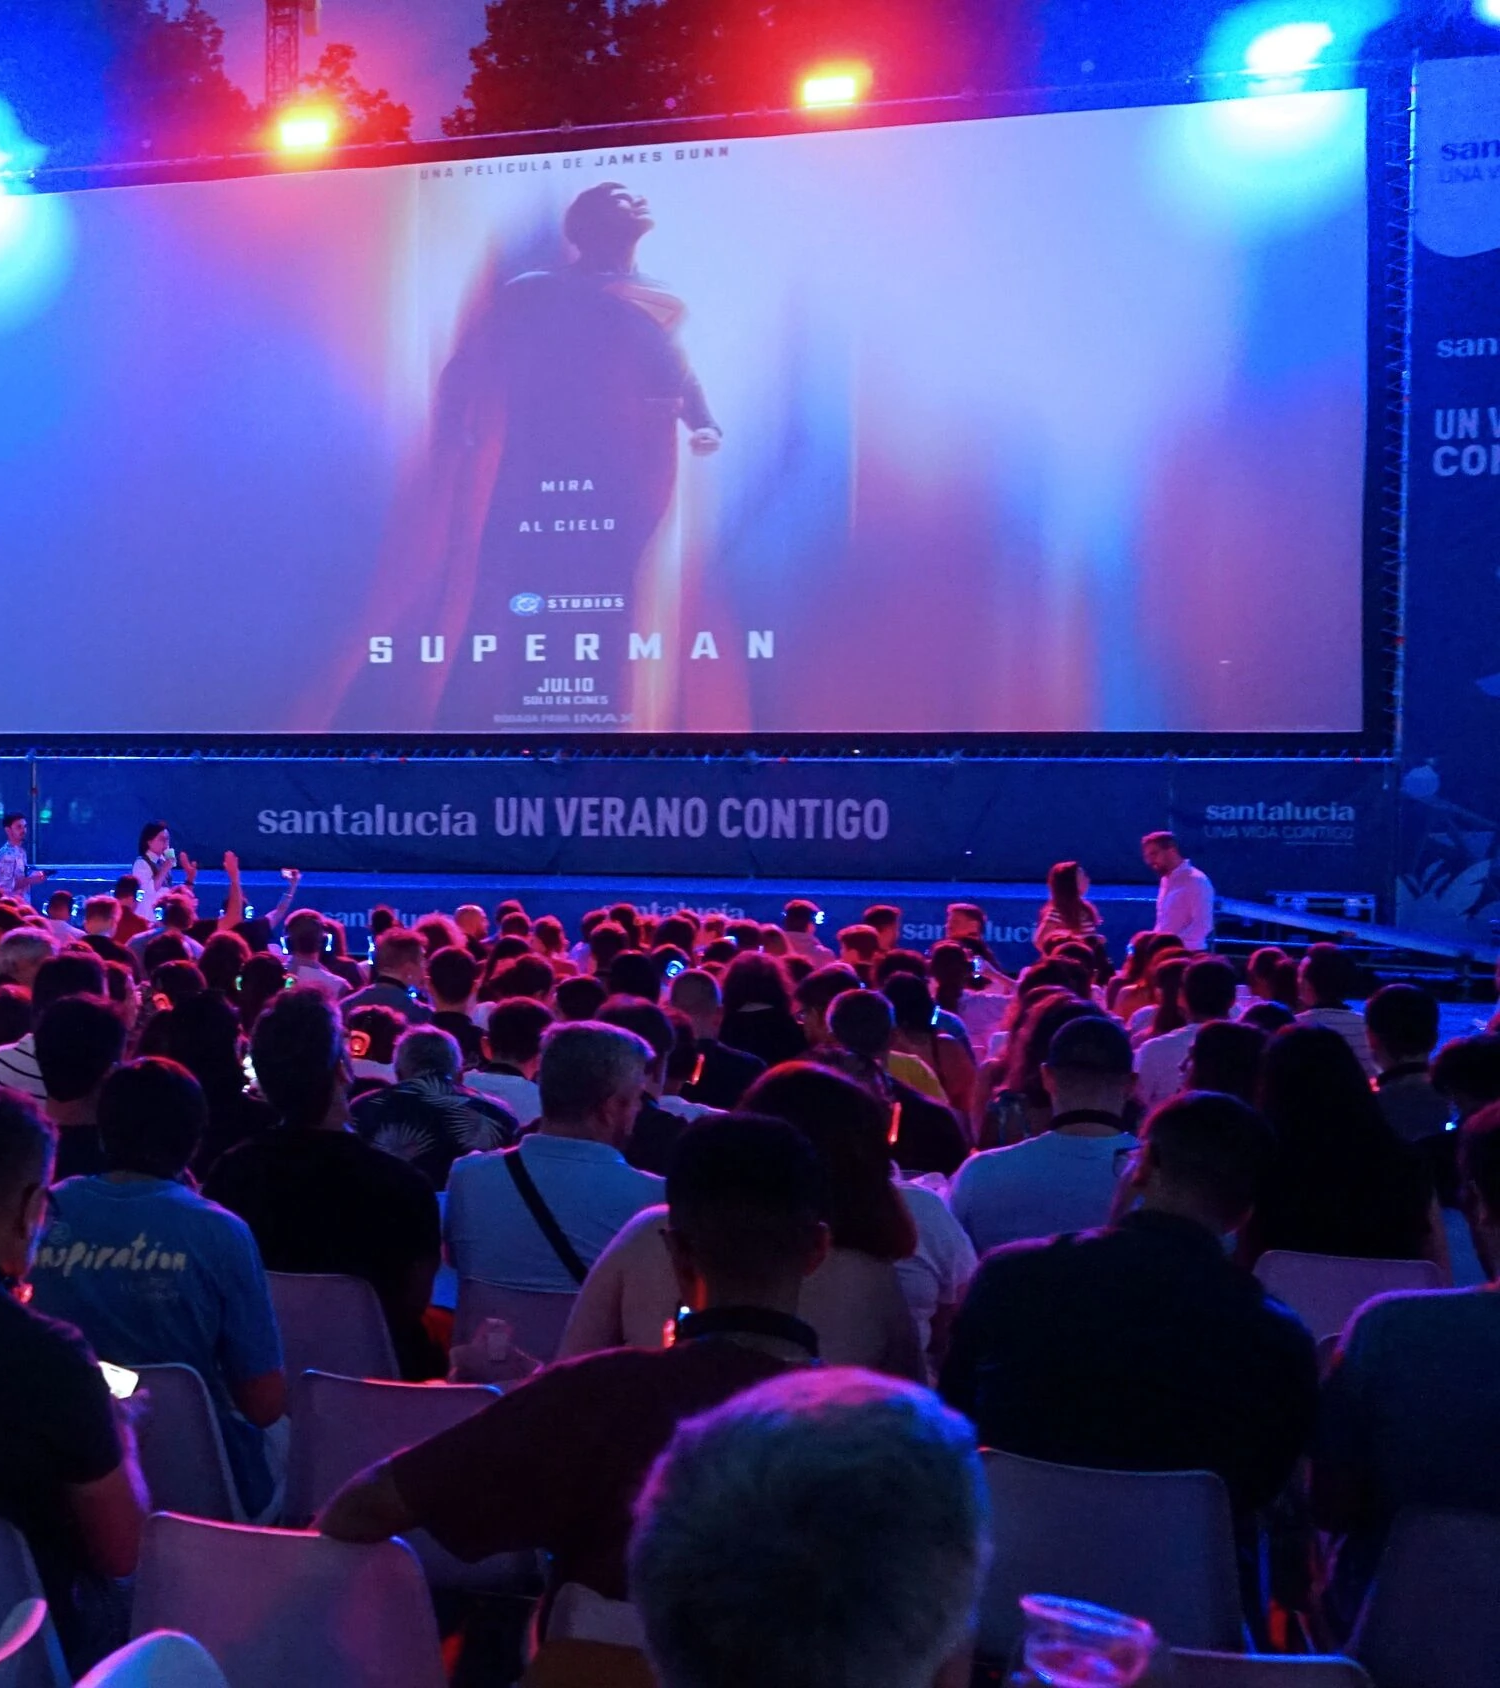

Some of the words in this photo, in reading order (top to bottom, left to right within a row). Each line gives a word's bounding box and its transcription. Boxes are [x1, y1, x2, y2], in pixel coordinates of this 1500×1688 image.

[419, 167, 454, 180] UNA
[465, 160, 551, 177] PELÍCULA
[563, 157, 583, 169] DE
[594, 151, 662, 167] JAMES
[675, 146, 730, 160] GUNN
[1434, 407, 1480, 440] UN
[541, 479, 594, 492] MIRA
[519, 520, 543, 532] AL
[554, 518, 615, 531] CIELO
[547, 597, 625, 609] STUDIOS
[369, 630, 775, 663] SUPERMAN
[537, 677, 594, 693] JULIO
[574, 713, 633, 723] IMAX
[257, 803, 477, 836] santalucía
[494, 797, 544, 837] UN
[555, 797, 708, 838] VERANO
[718, 797, 890, 840] CONTIGO
[1205, 801, 1355, 822] santalucía
[35, 1231, 187, 1278] nspiration
